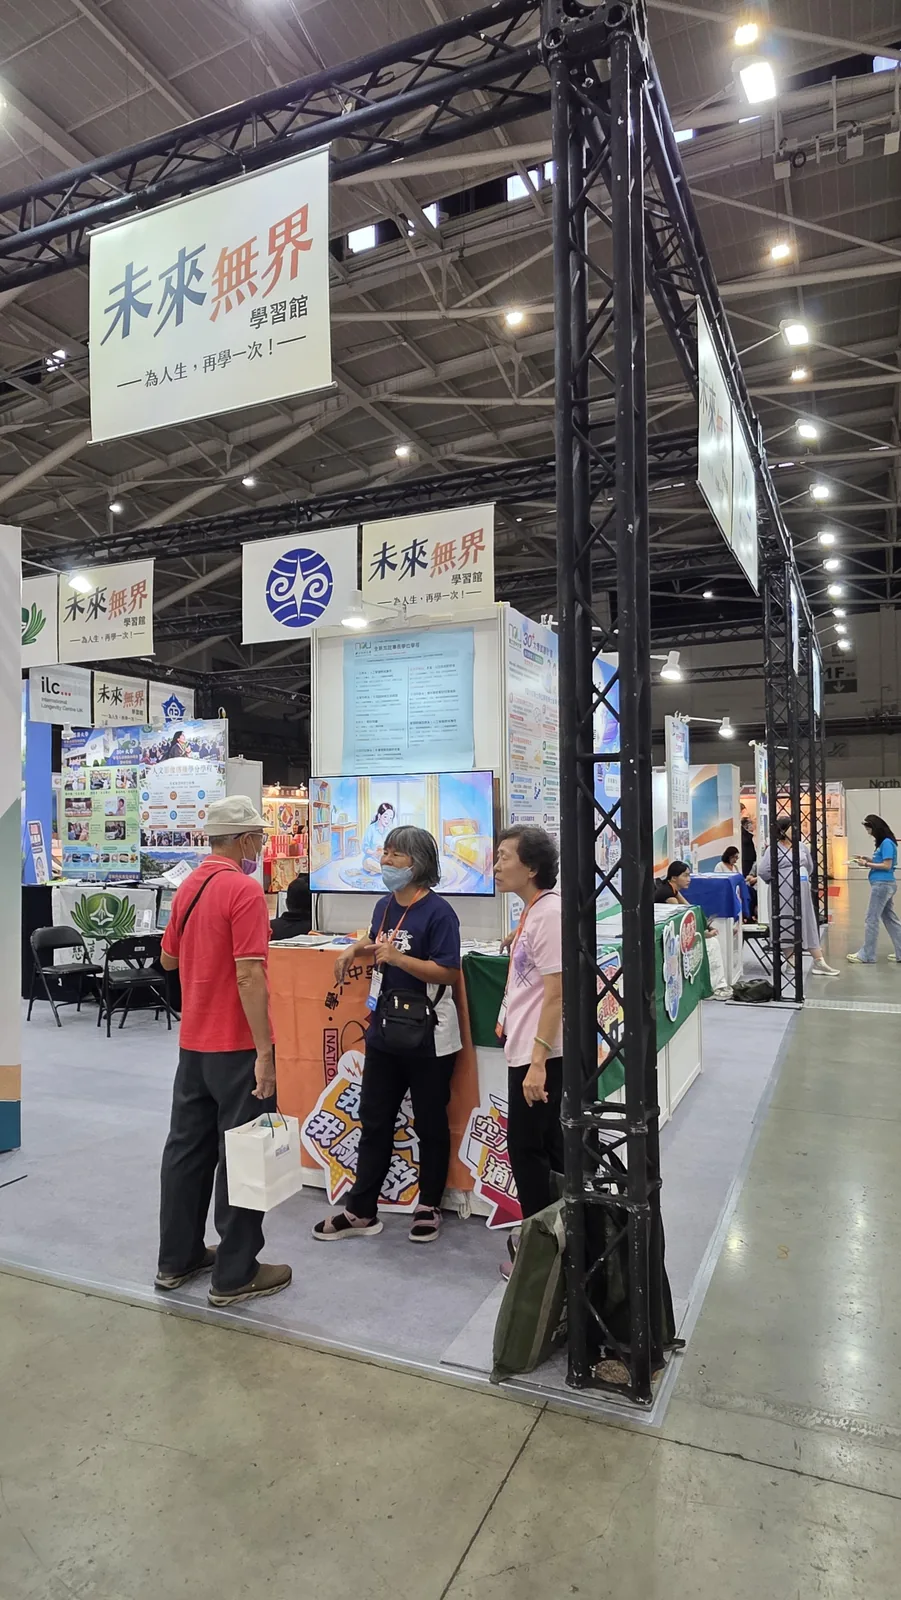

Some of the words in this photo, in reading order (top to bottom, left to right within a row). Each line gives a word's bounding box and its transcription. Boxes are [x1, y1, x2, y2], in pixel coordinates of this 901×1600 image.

[101, 203, 313, 346] 未來無界
[249, 295, 308, 329] 學習館
[368, 528, 486, 582] 未來無界
[452, 572, 483, 585] 學習館
[63, 579, 148, 623] 未來無界
[124, 615, 146, 627] 學習館
[41, 697, 67, 705] International
[97, 683, 144, 708] 未來無界
[41, 703, 61, 711] Longevity
[869, 778, 900, 789] North
